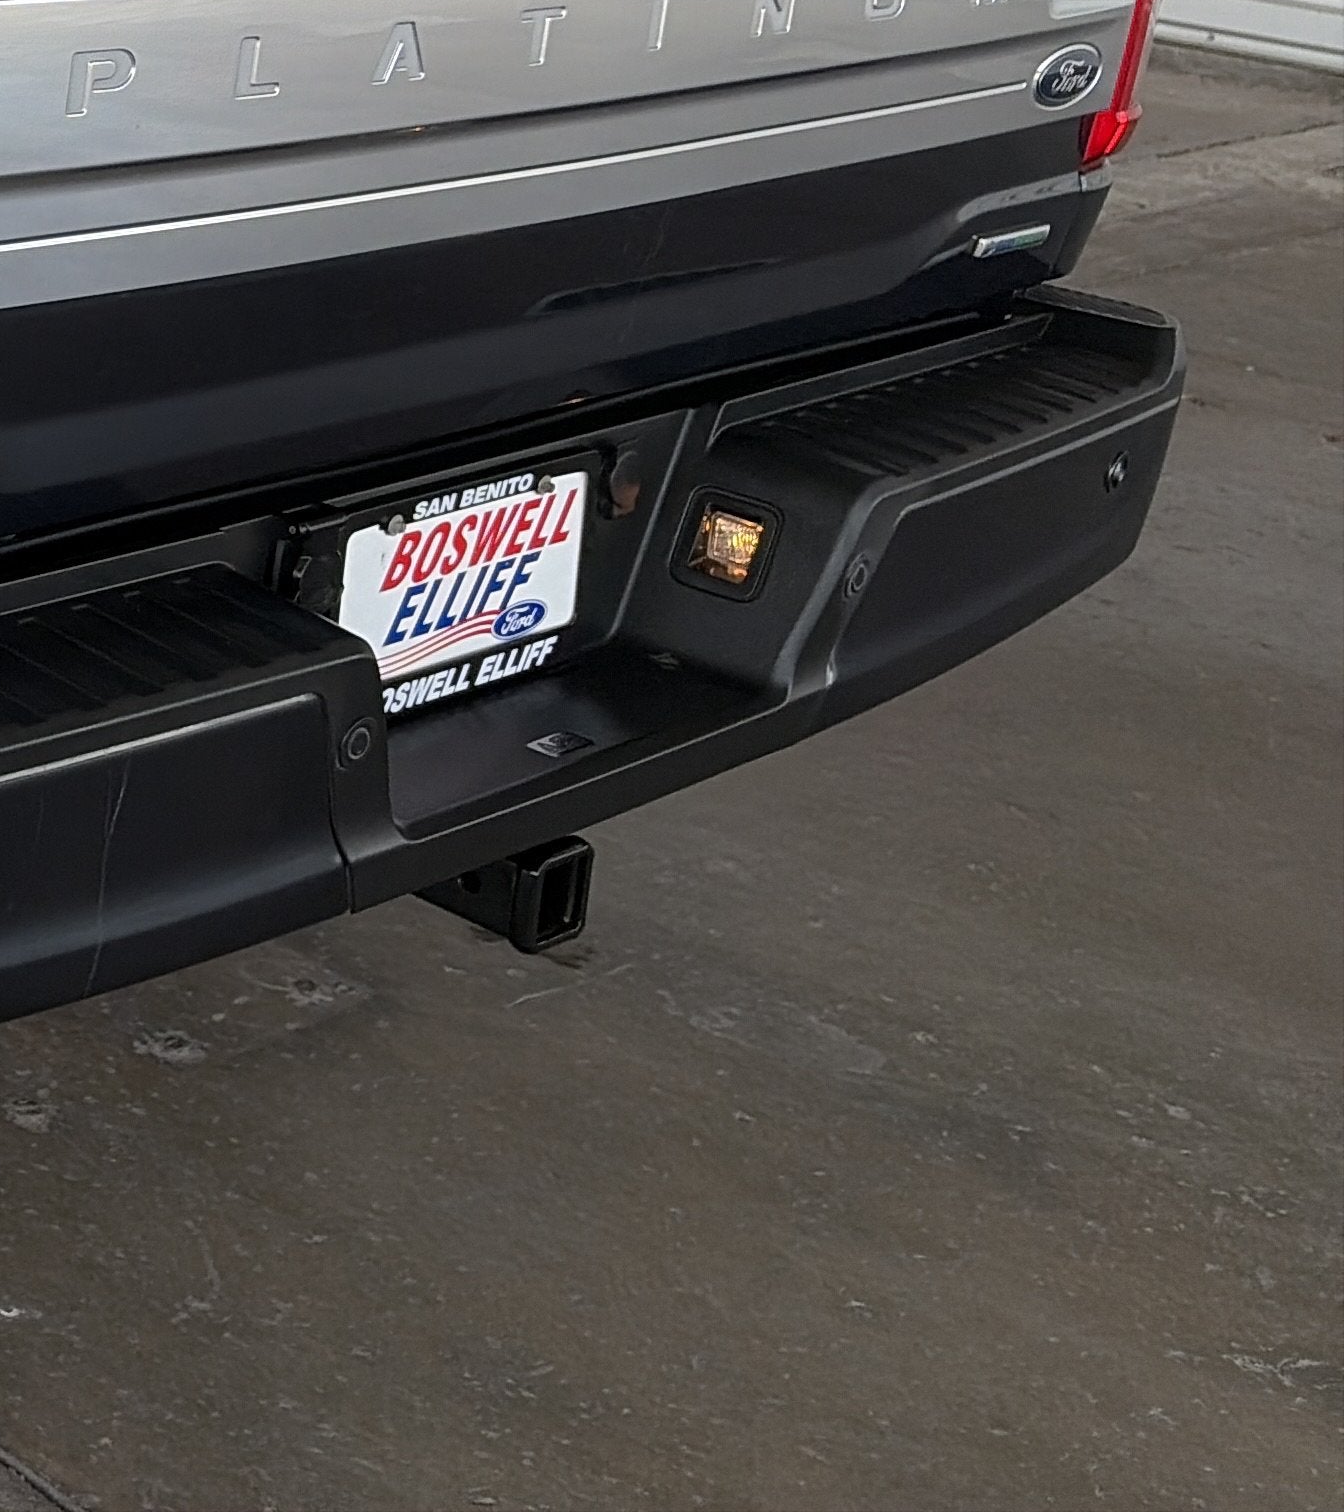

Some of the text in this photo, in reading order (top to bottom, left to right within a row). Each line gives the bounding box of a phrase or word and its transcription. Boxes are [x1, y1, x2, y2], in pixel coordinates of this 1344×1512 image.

[1051, 59, 1093, 93] Ford
[412, 473, 535, 521] SAN BENITO
[379, 488, 579, 593] BOSWELL
[382, 550, 543, 647] ELLIFF
[500, 605, 539, 635] Ford
[382, 635, 558, 714] OSWELL ELLIFF
